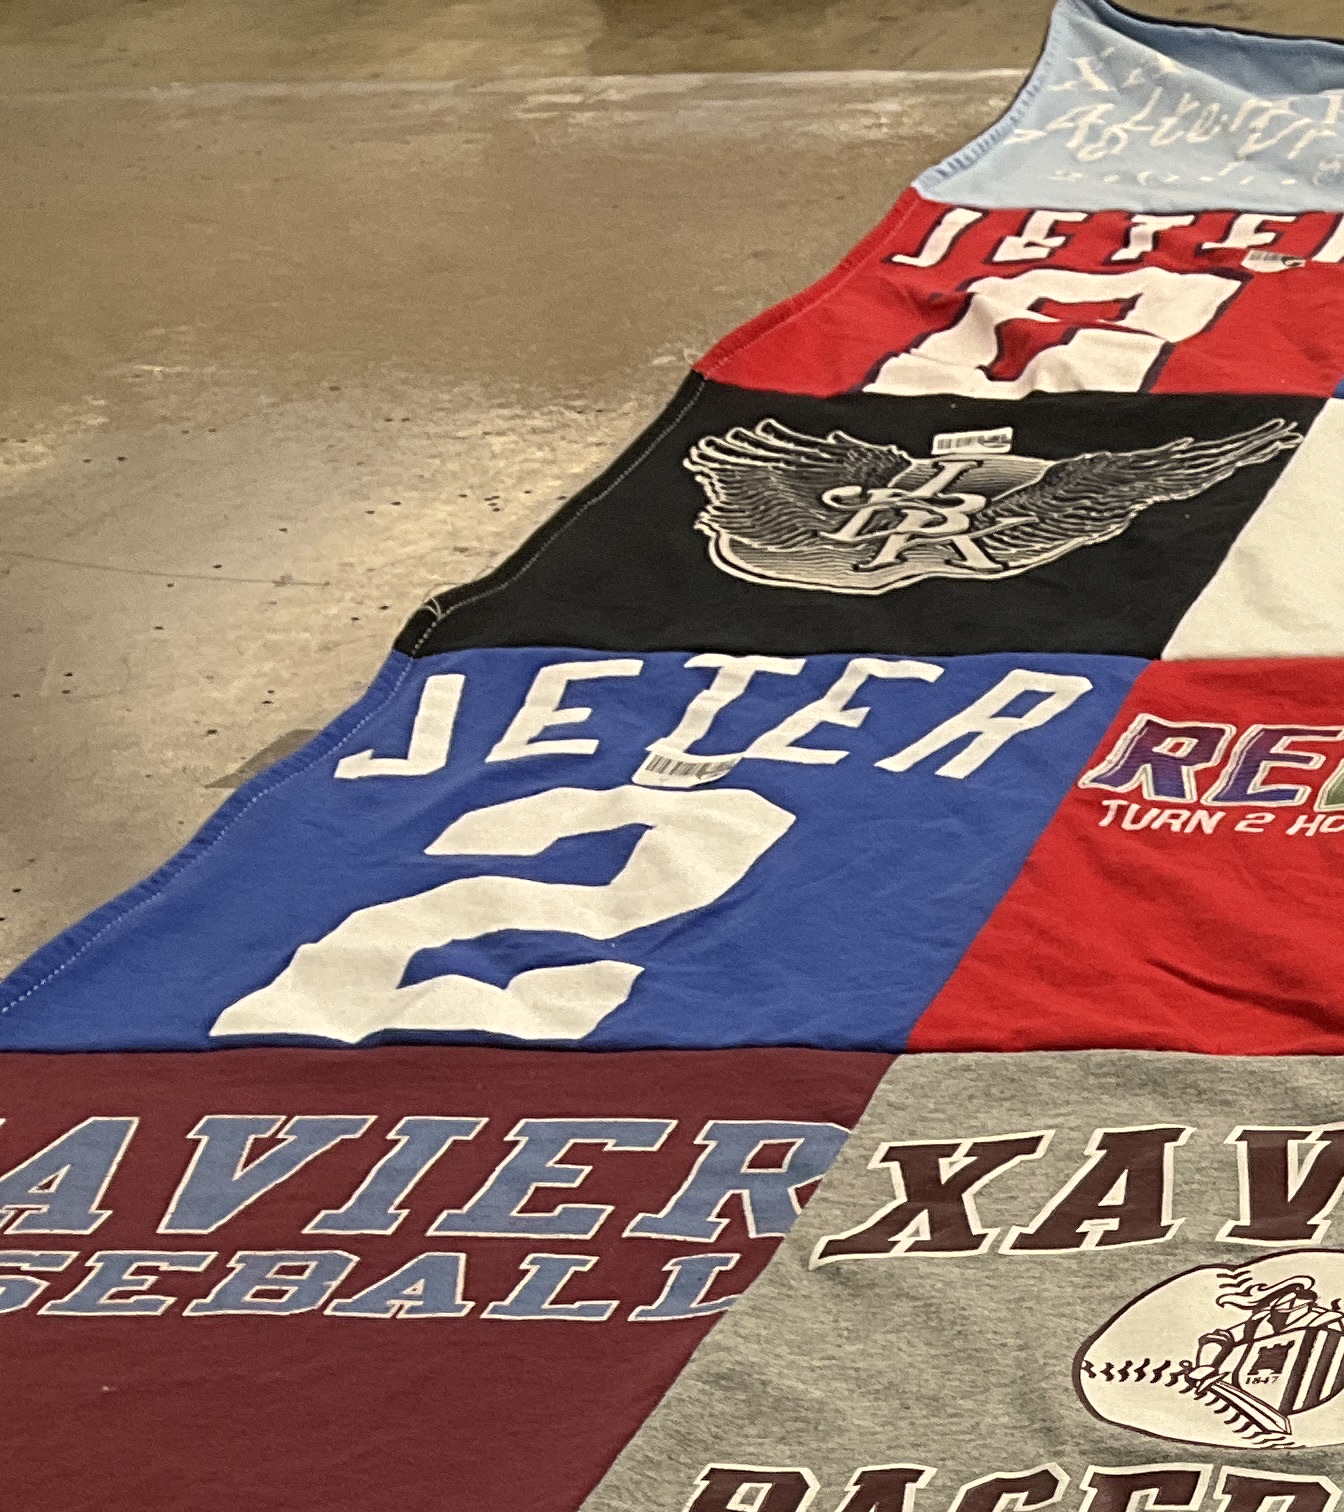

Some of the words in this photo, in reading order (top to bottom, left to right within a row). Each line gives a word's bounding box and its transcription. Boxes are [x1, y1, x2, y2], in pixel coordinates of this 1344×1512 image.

[334, 653, 1094, 780] JETER
[1097, 799, 1226, 832] TURN
[1235, 812, 1272, 835] 2
[207, 784, 798, 1045] 2
[0, 1114, 852, 1242] AVIER
